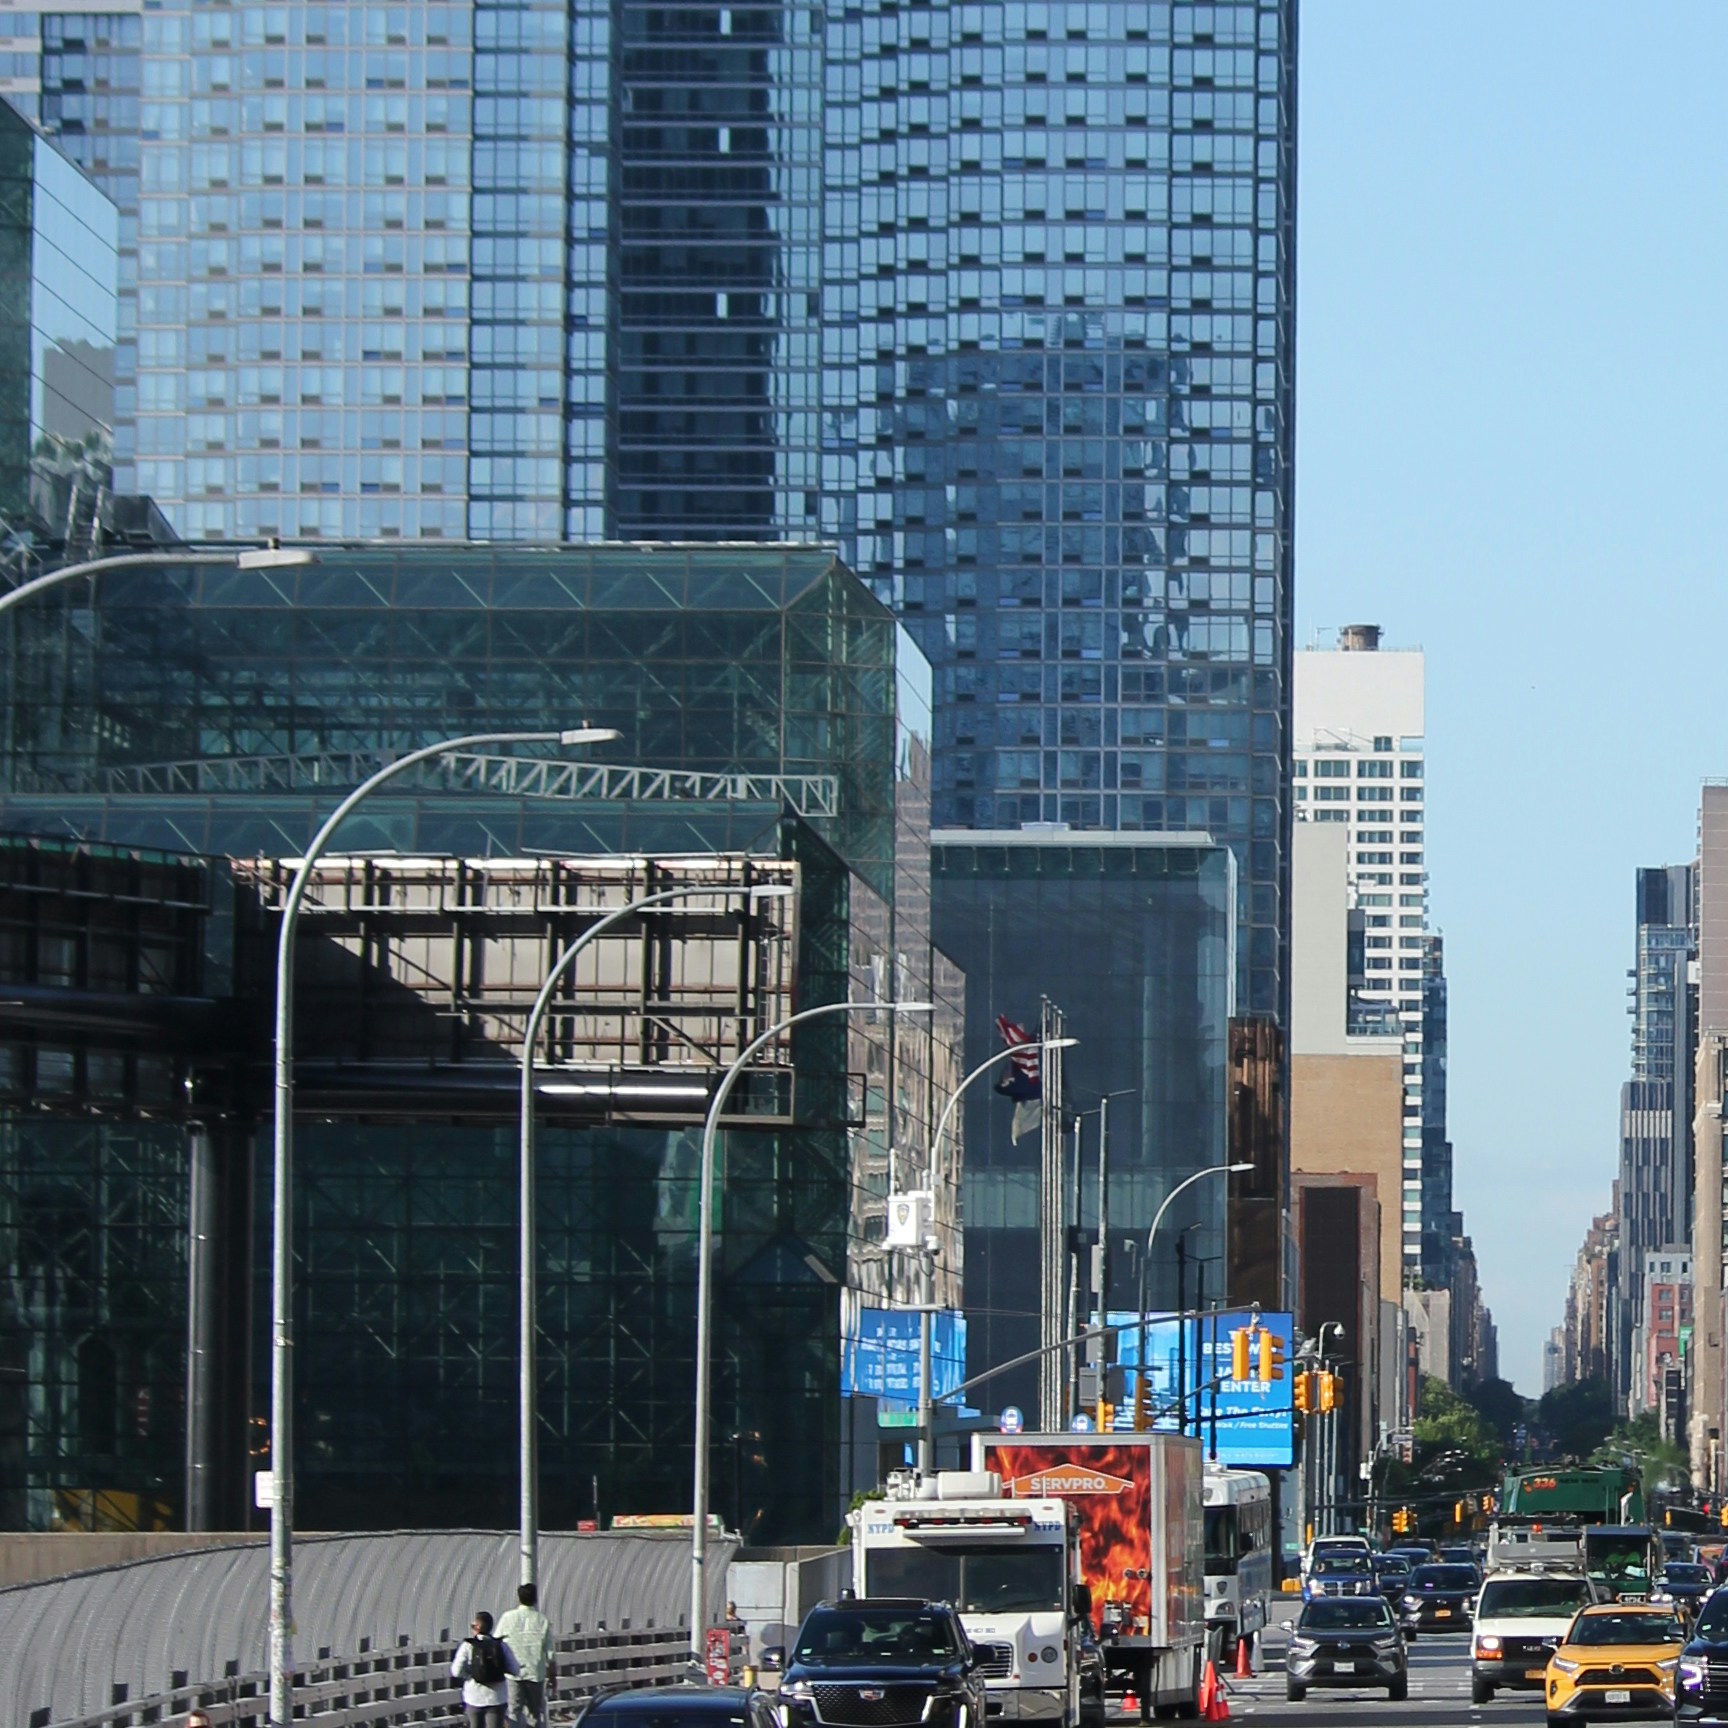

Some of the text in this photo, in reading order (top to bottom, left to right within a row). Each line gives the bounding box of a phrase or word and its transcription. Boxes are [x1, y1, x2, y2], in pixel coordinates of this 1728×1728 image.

[1221, 1381, 1271, 1393] ENTER
[1533, 1478, 1557, 1489] 336
[867, 1523, 895, 1534] NYPD
[1033, 1522, 1062, 1532] NYPD
